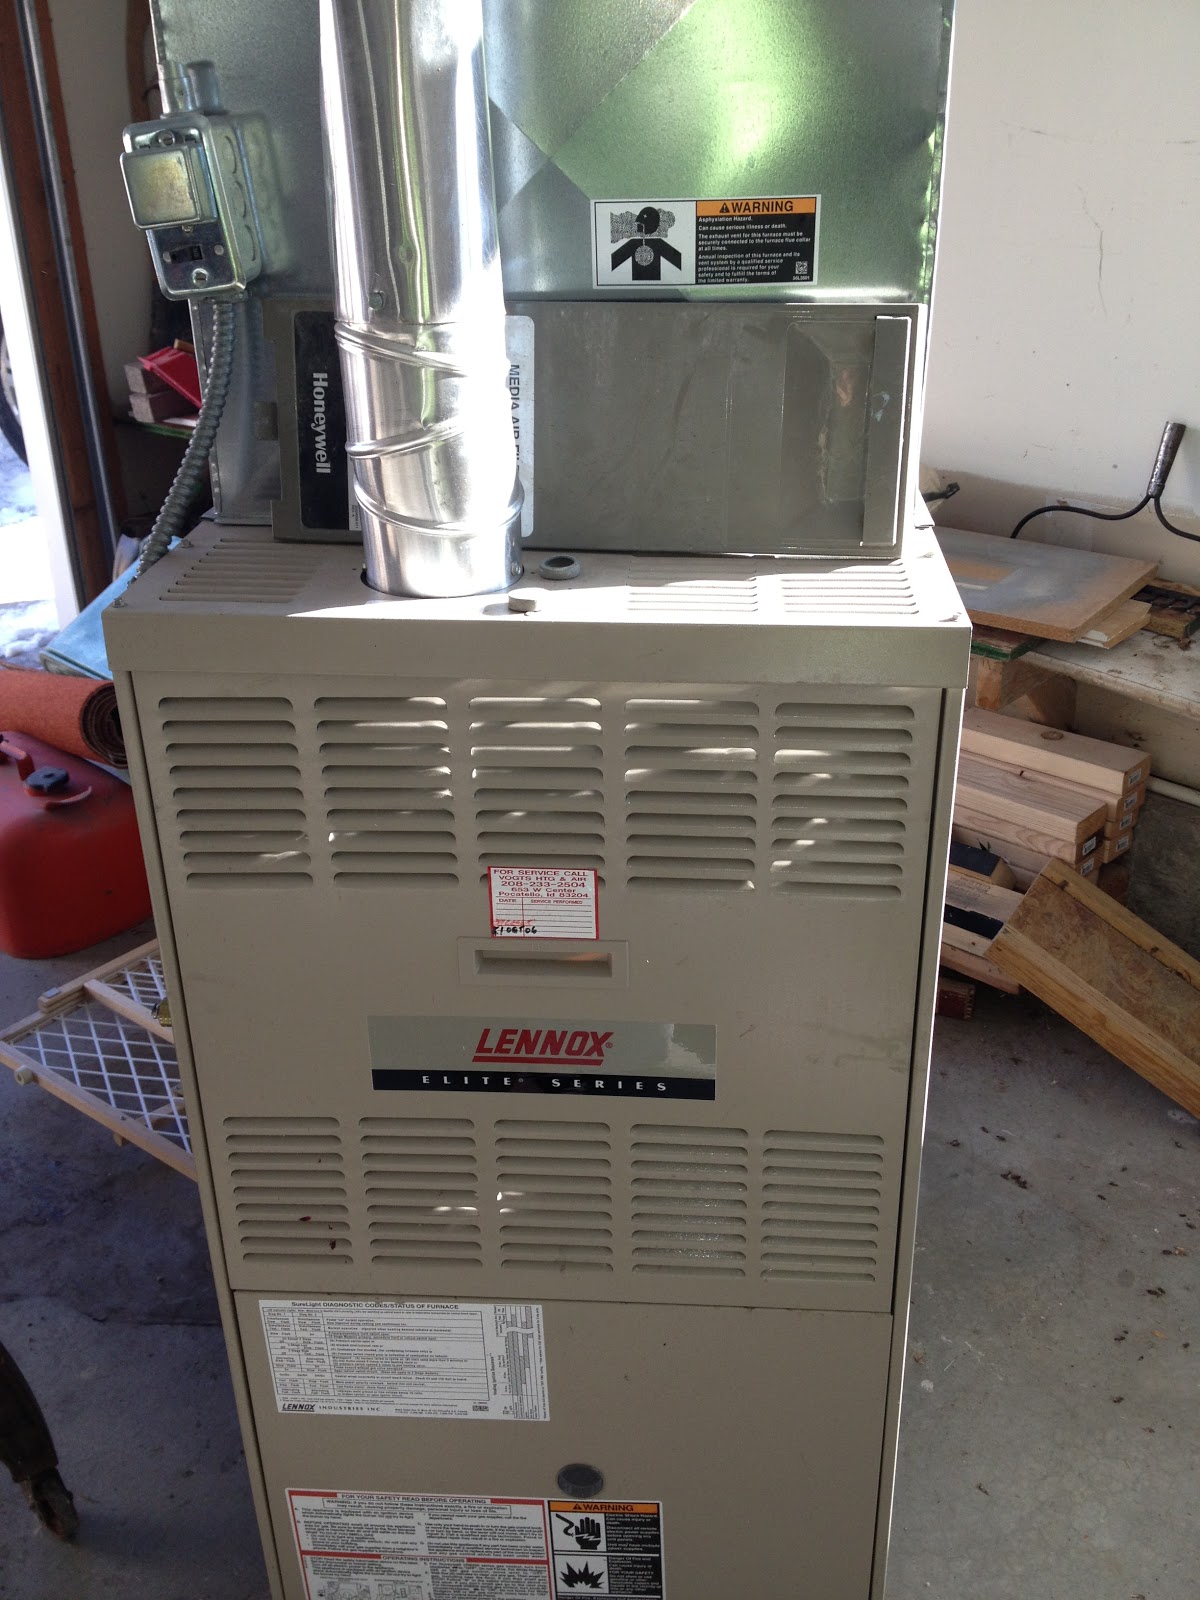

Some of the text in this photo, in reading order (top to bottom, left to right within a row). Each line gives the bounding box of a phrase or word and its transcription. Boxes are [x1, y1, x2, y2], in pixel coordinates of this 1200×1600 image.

[732, 201, 793, 213] WARNING
[311, 372, 331, 473] Honeywell
[552, 1079, 667, 1091] SERIES
